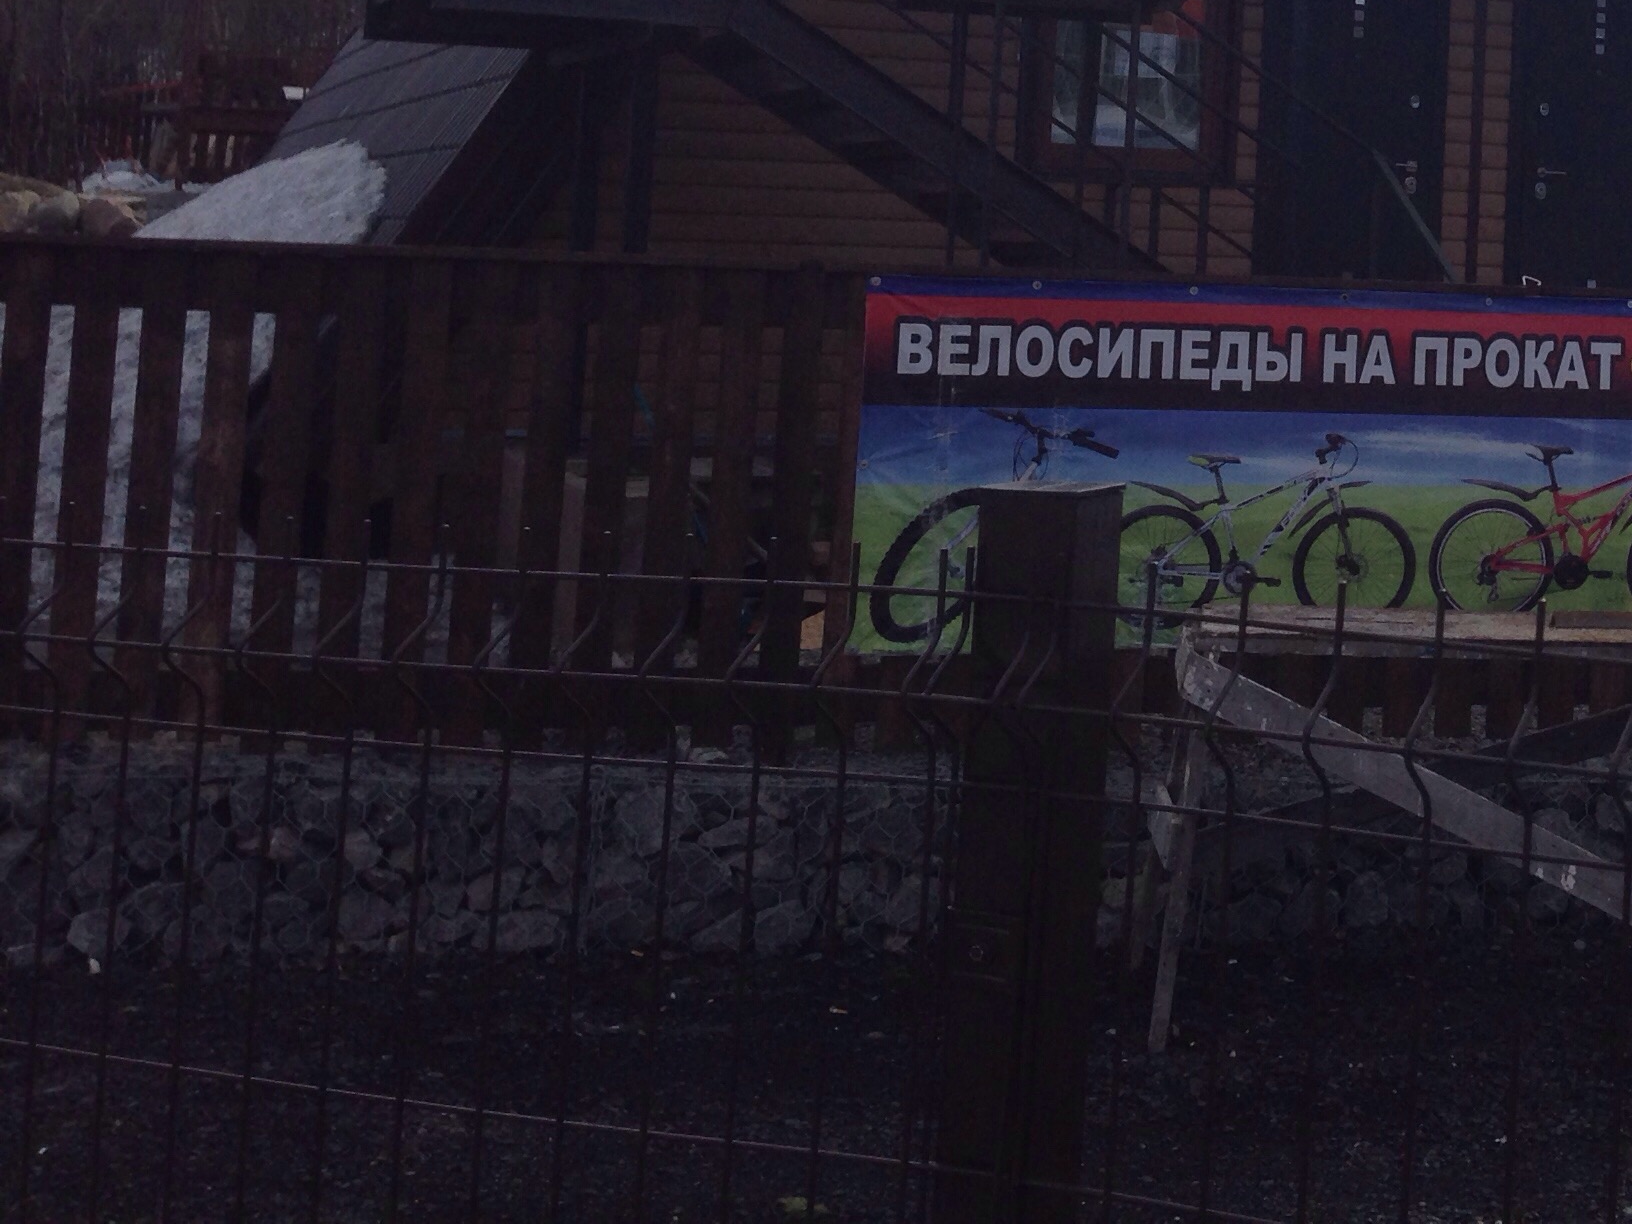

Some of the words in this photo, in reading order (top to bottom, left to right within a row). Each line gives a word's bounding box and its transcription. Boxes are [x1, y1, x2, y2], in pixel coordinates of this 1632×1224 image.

[896, 321, 1303, 393] ВЕЛОСИПЕДЫ
[1321, 332, 1397, 385] НА
[1413, 336, 1622, 391] ПРОКАТ
